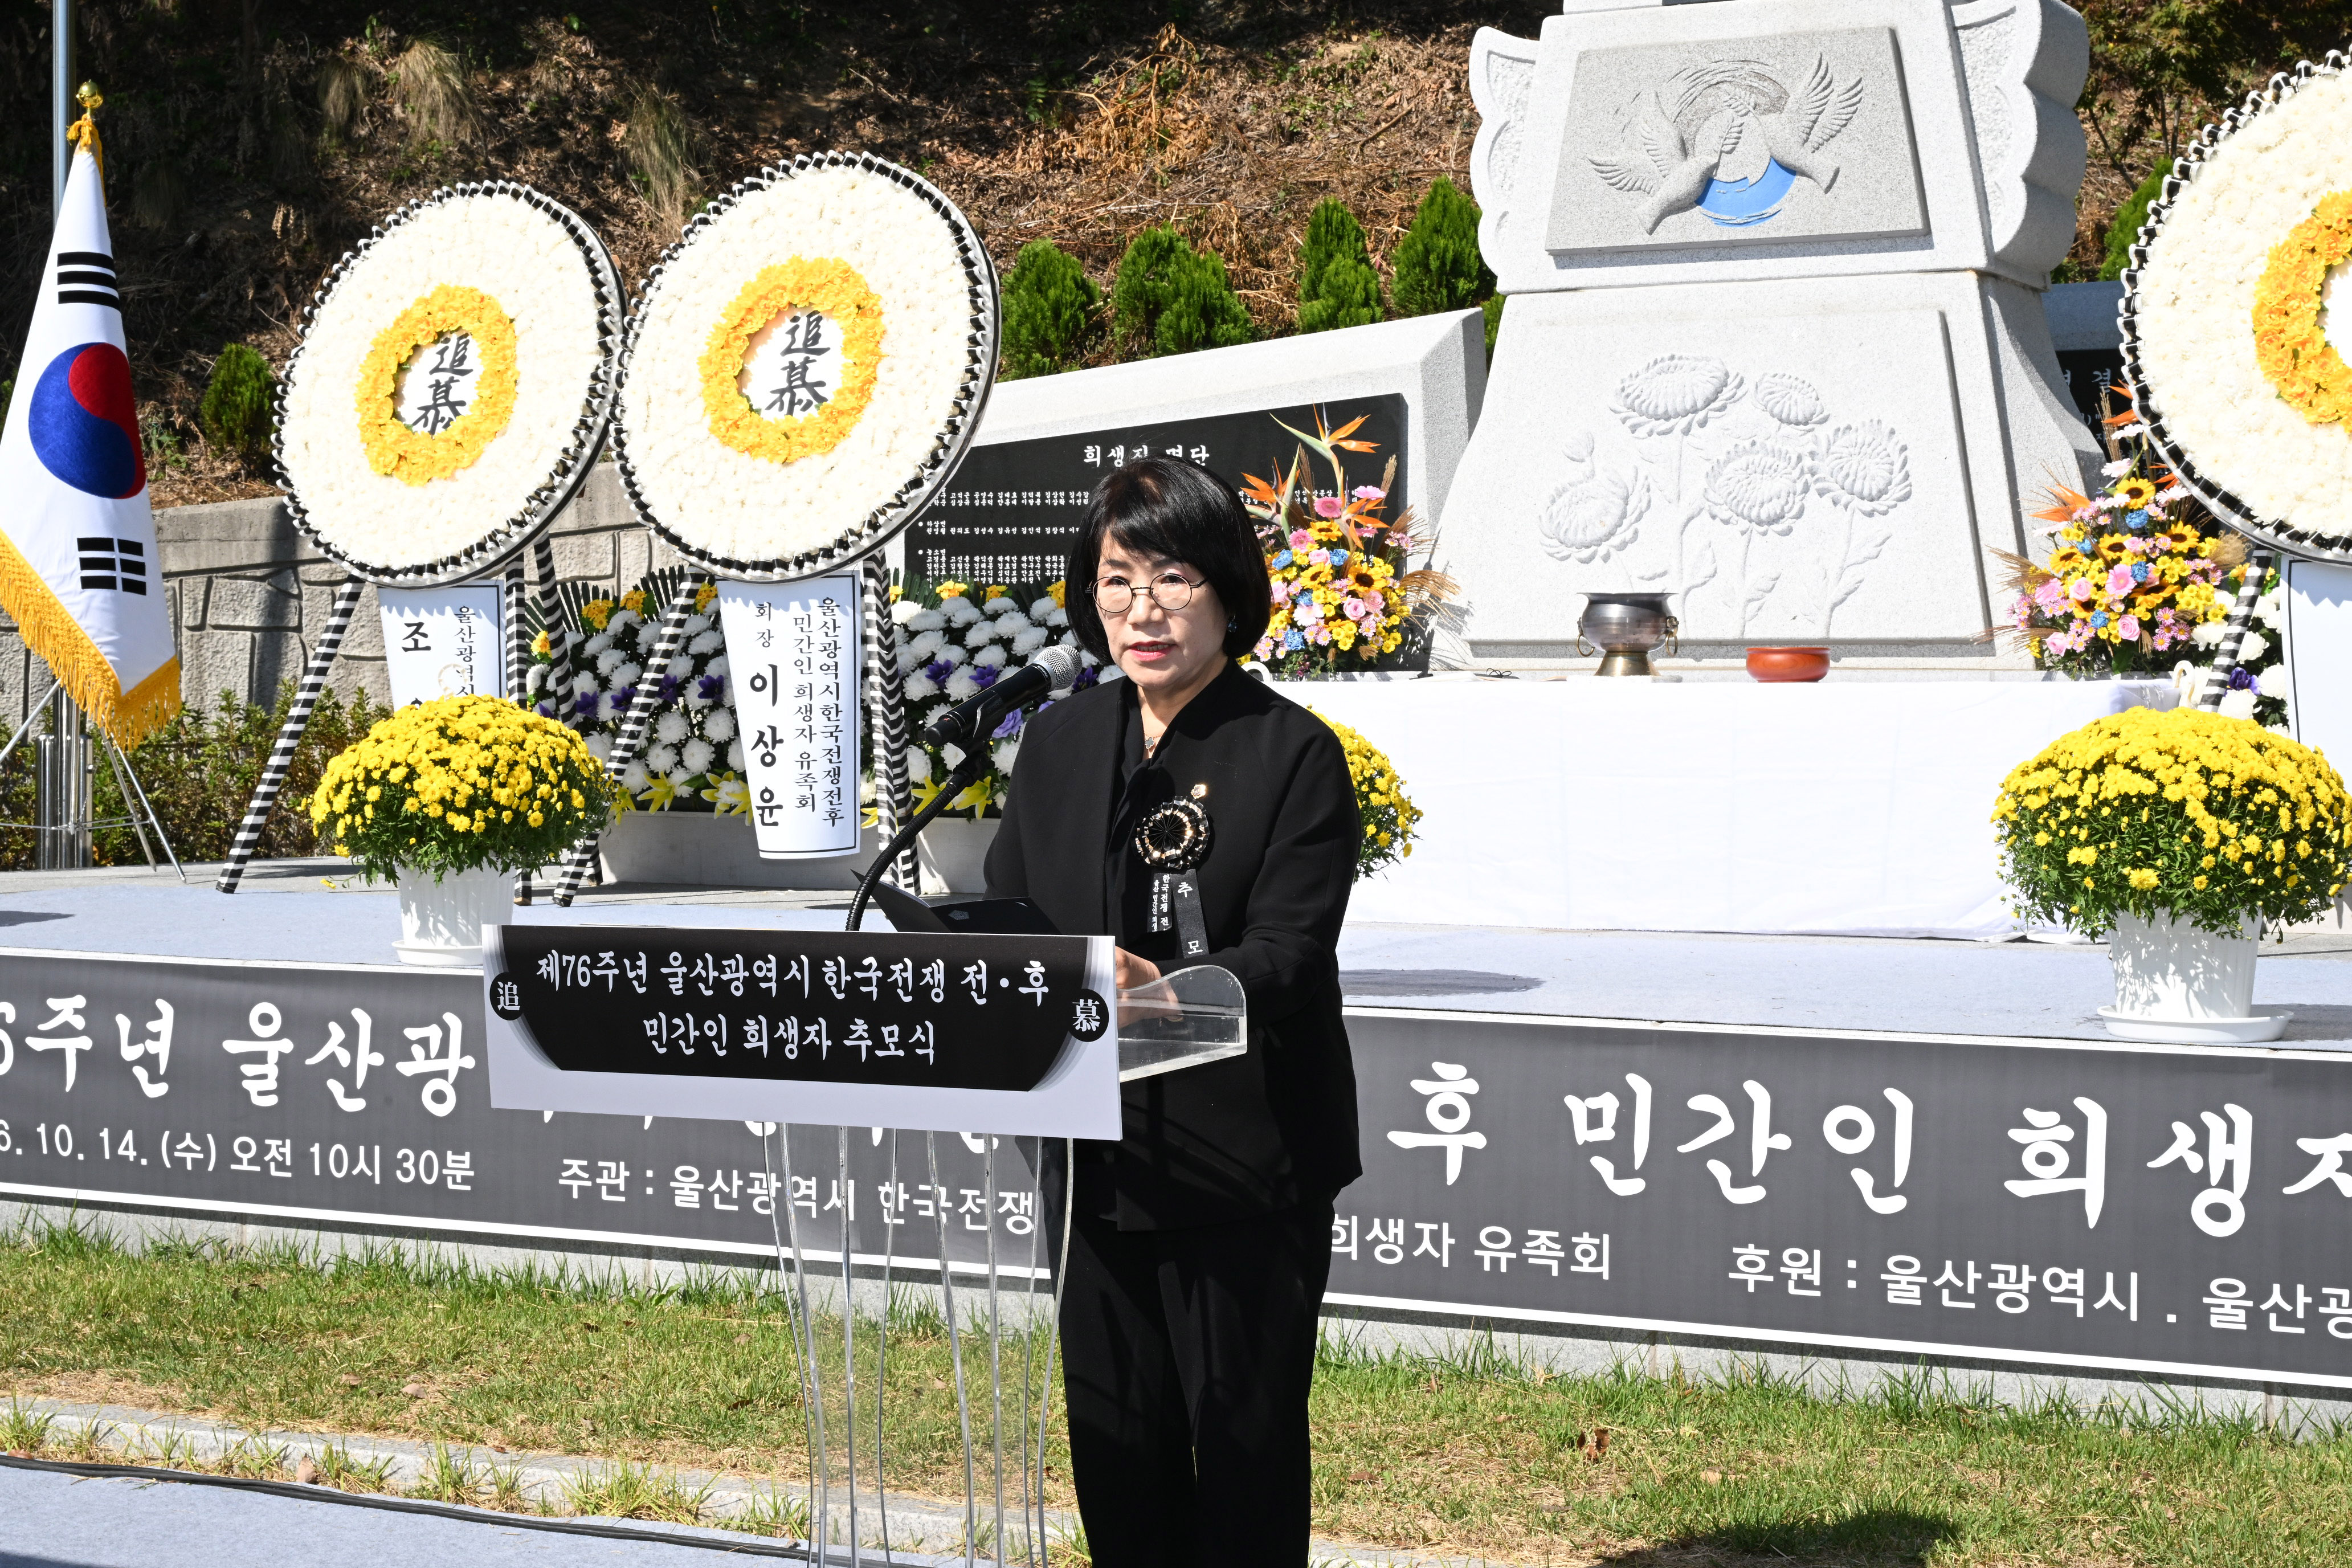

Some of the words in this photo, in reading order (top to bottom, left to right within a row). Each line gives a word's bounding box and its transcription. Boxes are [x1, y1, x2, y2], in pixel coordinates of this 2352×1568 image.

[415, 333, 474, 436] 追慕
[763, 310, 832, 415] 追慕
[793, 614, 814, 675] 민간인
[793, 682, 817, 744] 희생자
[794, 751, 818, 813] 유족회
[1161, 874, 1170, 913] 한국전쟁
[1177, 882, 1203, 954] 추모
[497, 979, 521, 1012] 追
[537, 950, 646, 993] 제76주년
[660, 952, 808, 998] 울산광역시
[822, 956, 944, 1002] 한국전쟁
[643, 1012, 726, 1056] 민간인
[744, 1015, 831, 1060] 희생자
[843, 1018, 934, 1065] 추모식
[1072, 999, 1101, 1032] 慕
[223, 1002, 475, 1117] 울산광
[1564, 1073, 1913, 1214] 민간인
[37, 1124, 84, 1159] 10.
[231, 1137, 291, 1177] 오전
[311, 1143, 379, 1184] 10시
[397, 1149, 474, 1190] 30분
[559, 1159, 630, 1201] 주관
[669, 1166, 855, 1221] 울산광역시
[878, 1181, 1034, 1235] 한국전쟁
[1475, 1226, 1609, 1280] 유족회
[1729, 1244, 1820, 1296] 후원
[1881, 1255, 2137, 1321] 울산광역시
